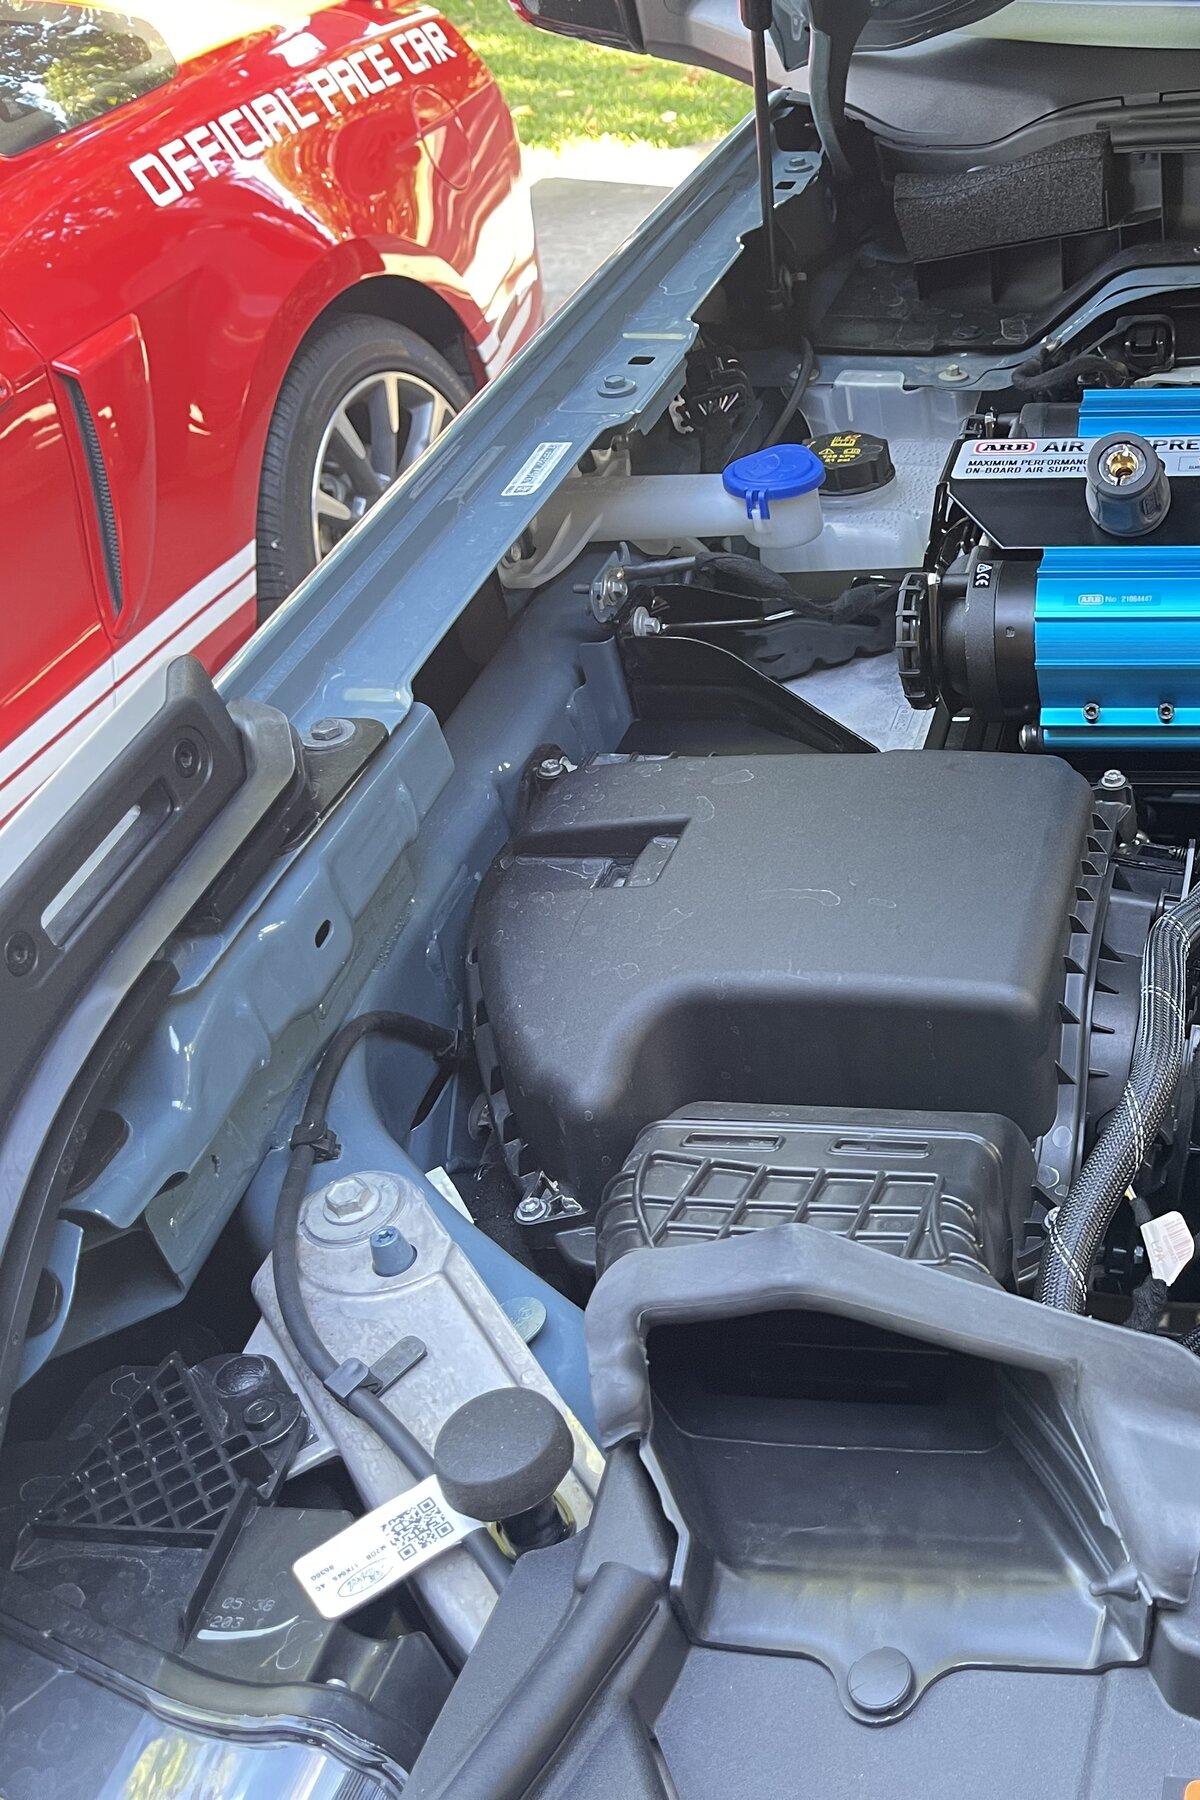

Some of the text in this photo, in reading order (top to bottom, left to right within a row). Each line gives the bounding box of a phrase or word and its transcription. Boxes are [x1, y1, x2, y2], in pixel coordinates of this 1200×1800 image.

[129, 22, 457, 207] OFFICIAL PACE CAR
[979, 443, 1032, 452] ARB
[1042, 440, 1085, 453] AIR
[1080, 595, 1102, 603] ARB
